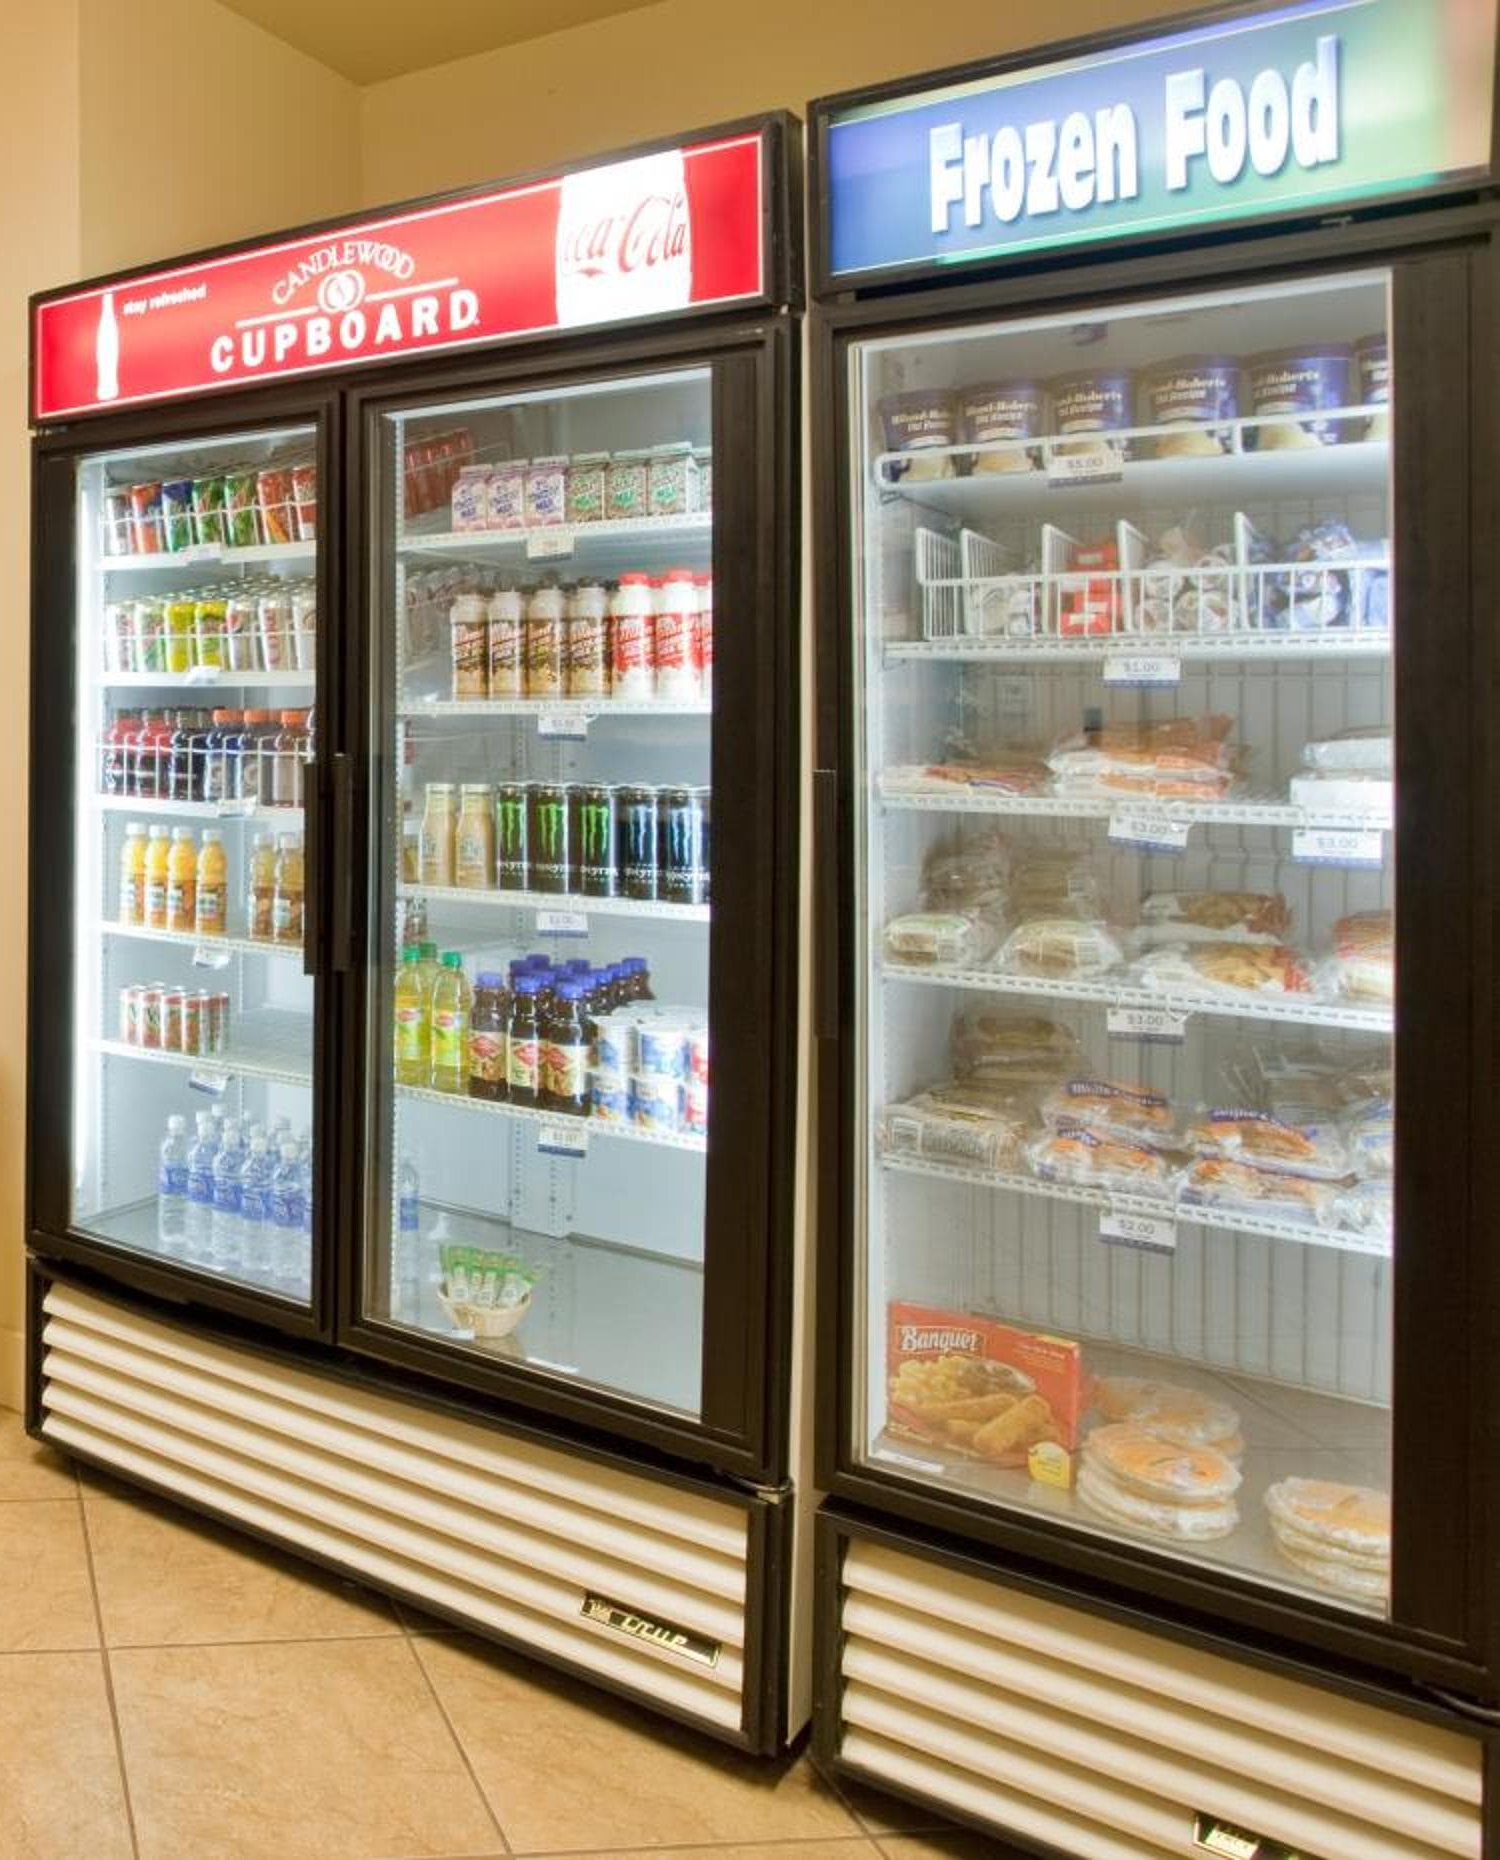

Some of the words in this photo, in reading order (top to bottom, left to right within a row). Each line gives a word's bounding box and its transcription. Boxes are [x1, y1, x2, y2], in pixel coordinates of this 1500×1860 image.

[928, 102, 1138, 234] Frozen
[1164, 34, 1340, 191] Food
[271, 240, 416, 305] CANDLEWOOD
[210, 288, 479, 373] CUPBOARD
[901, 1325, 978, 1354] Banquet
